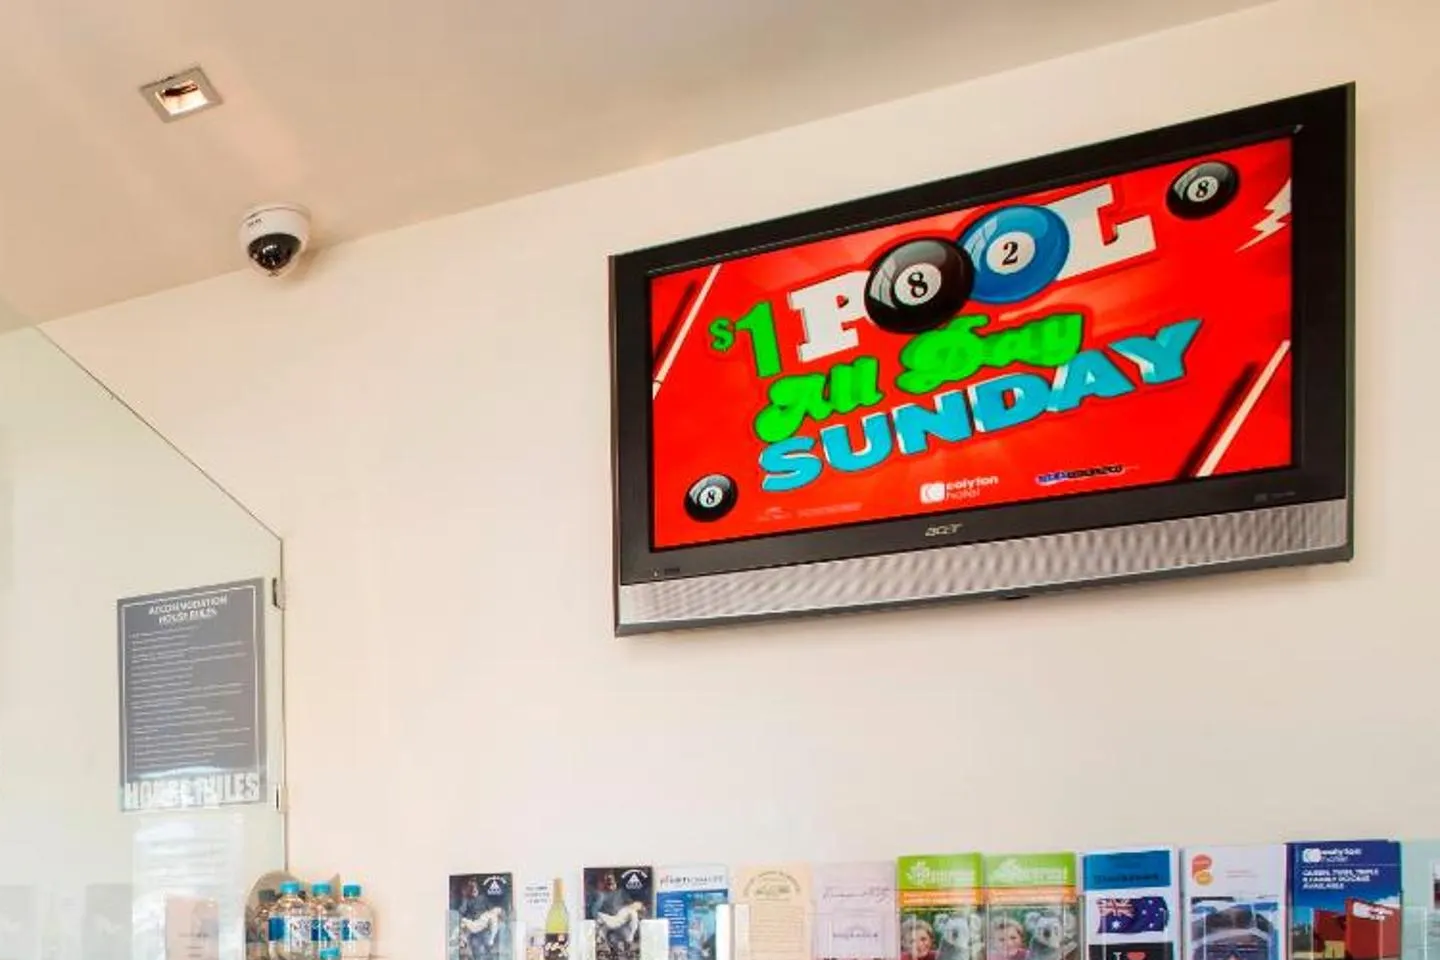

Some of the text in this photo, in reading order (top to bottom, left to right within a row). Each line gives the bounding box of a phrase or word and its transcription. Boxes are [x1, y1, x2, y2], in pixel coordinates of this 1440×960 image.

[1195, 180, 1209, 199] 8
[1001, 241, 1019, 266] 2
[909, 271, 929, 298] 8
[709, 302, 781, 378] $1
[759, 318, 1203, 493] SUNDAY
